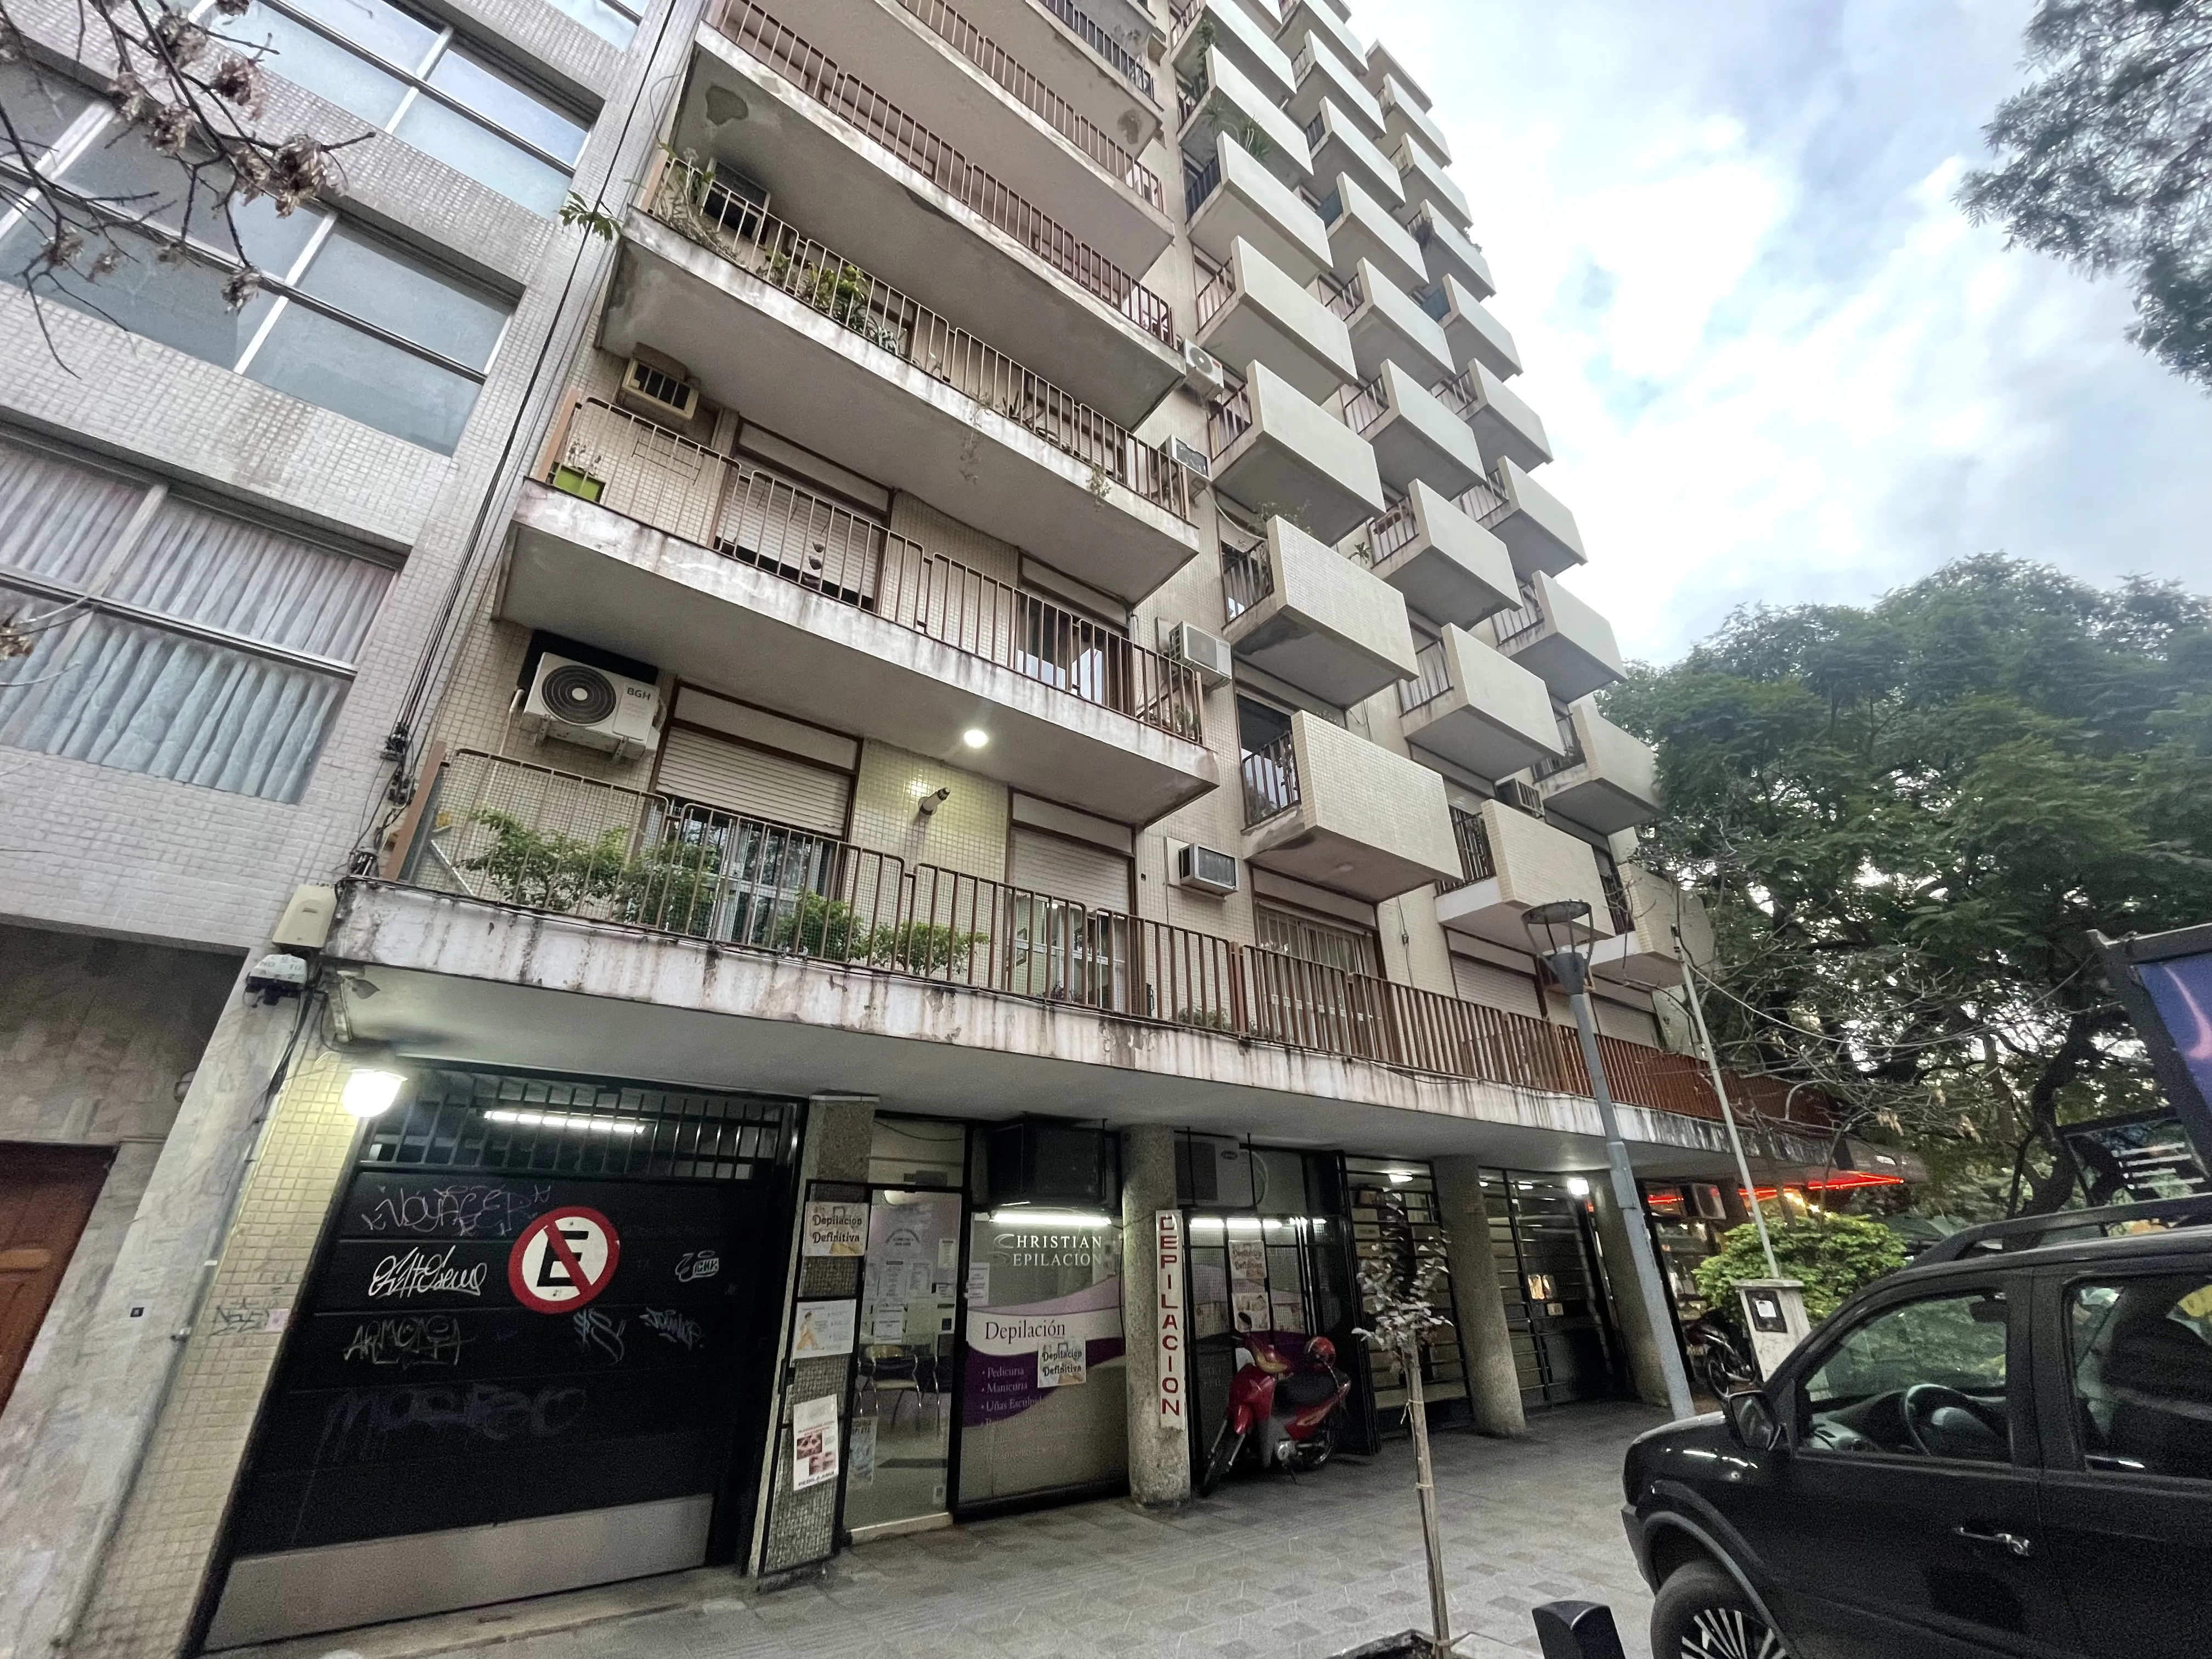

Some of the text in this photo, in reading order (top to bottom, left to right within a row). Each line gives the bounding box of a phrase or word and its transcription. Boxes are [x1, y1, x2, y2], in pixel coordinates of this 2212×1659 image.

[627, 687, 651, 701] BGH
[812, 1231, 860, 1244] Definitiva
[992, 1233, 1102, 1249] CHRISTIAN
[537, 1231, 589, 1287] E
[1160, 1216, 1180, 1417] DEPILACION
[985, 1319, 1065, 1344] Depilación
